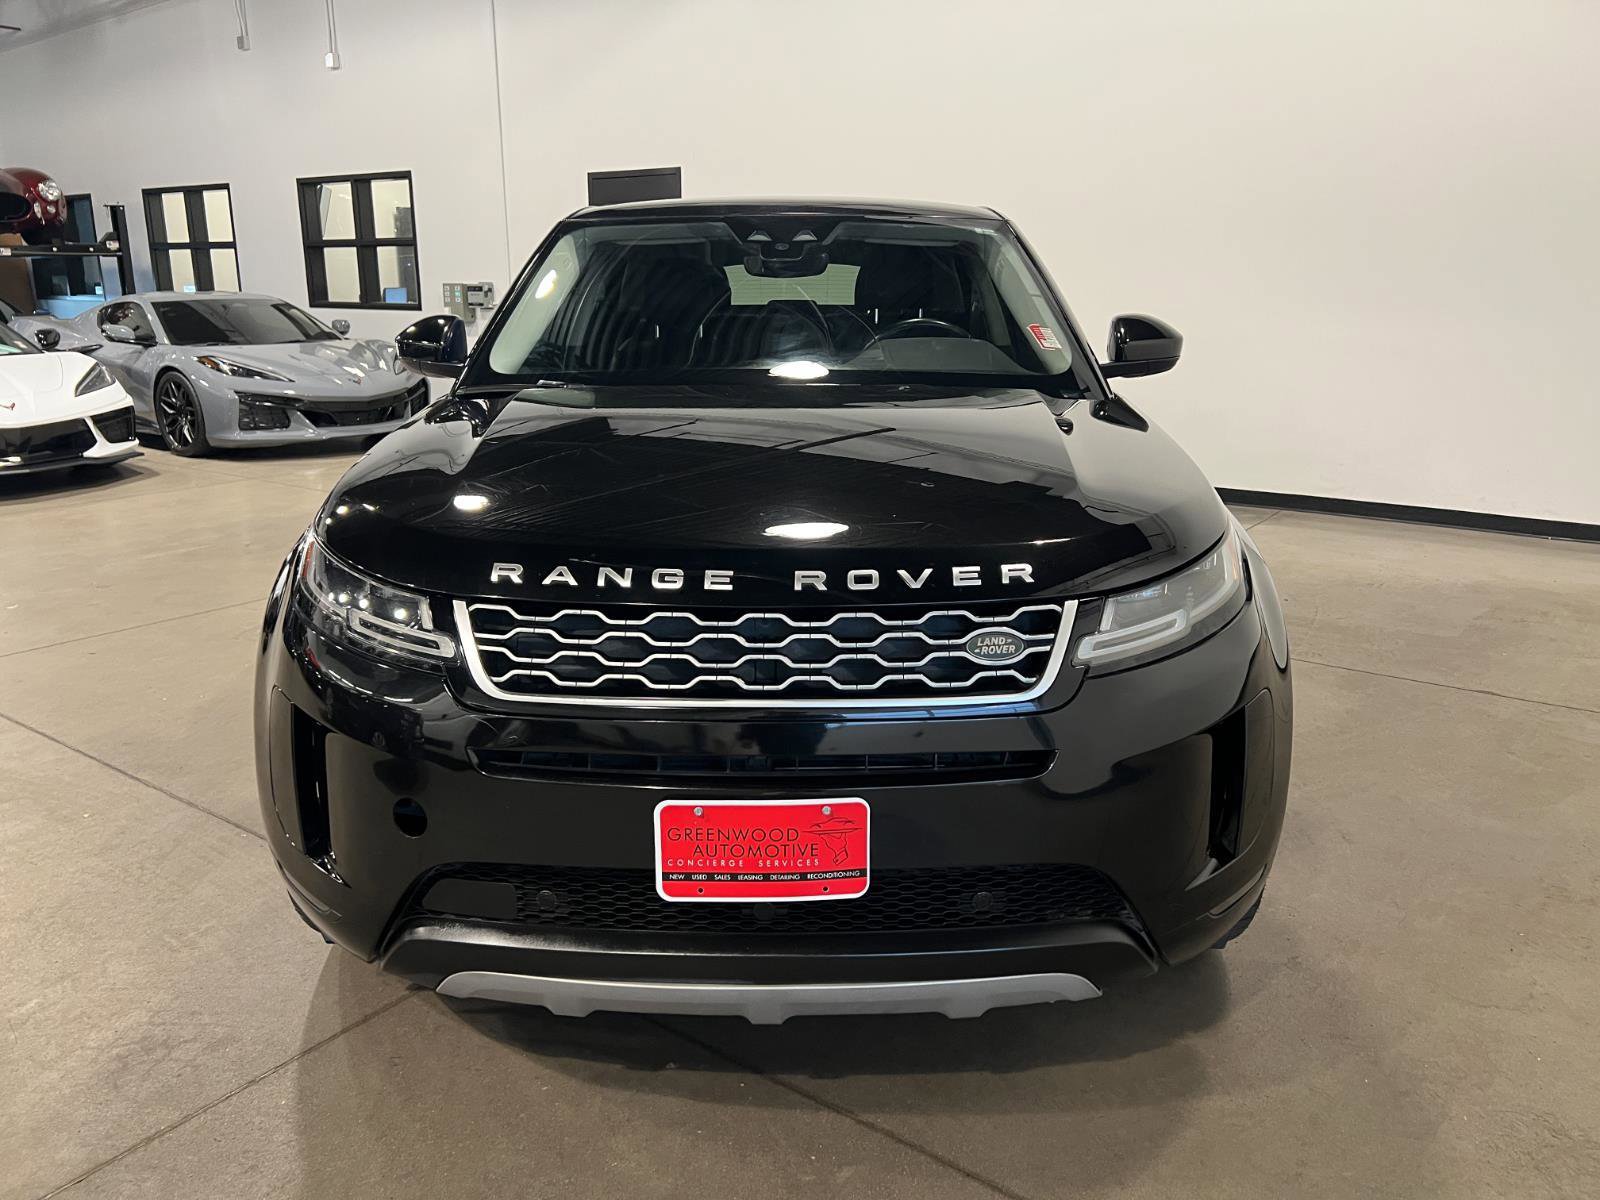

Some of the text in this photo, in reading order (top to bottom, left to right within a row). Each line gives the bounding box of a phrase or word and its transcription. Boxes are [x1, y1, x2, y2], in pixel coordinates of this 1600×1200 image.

[490, 562, 1035, 591] RANGE ROVER
[977, 636, 1006, 646] LAND
[980, 644, 1016, 655] ROVER
[667, 827, 799, 842] GREENWOOD
[693, 843, 819, 858] AUTOMOTIVE
[667, 858, 820, 868] CONCIERGE SERVICES
[714, 873, 731, 881] SALES
[737, 873, 764, 881] LEASING
[769, 873, 801, 881] DETAILING
[807, 870, 861, 880] RECONDITIONING
